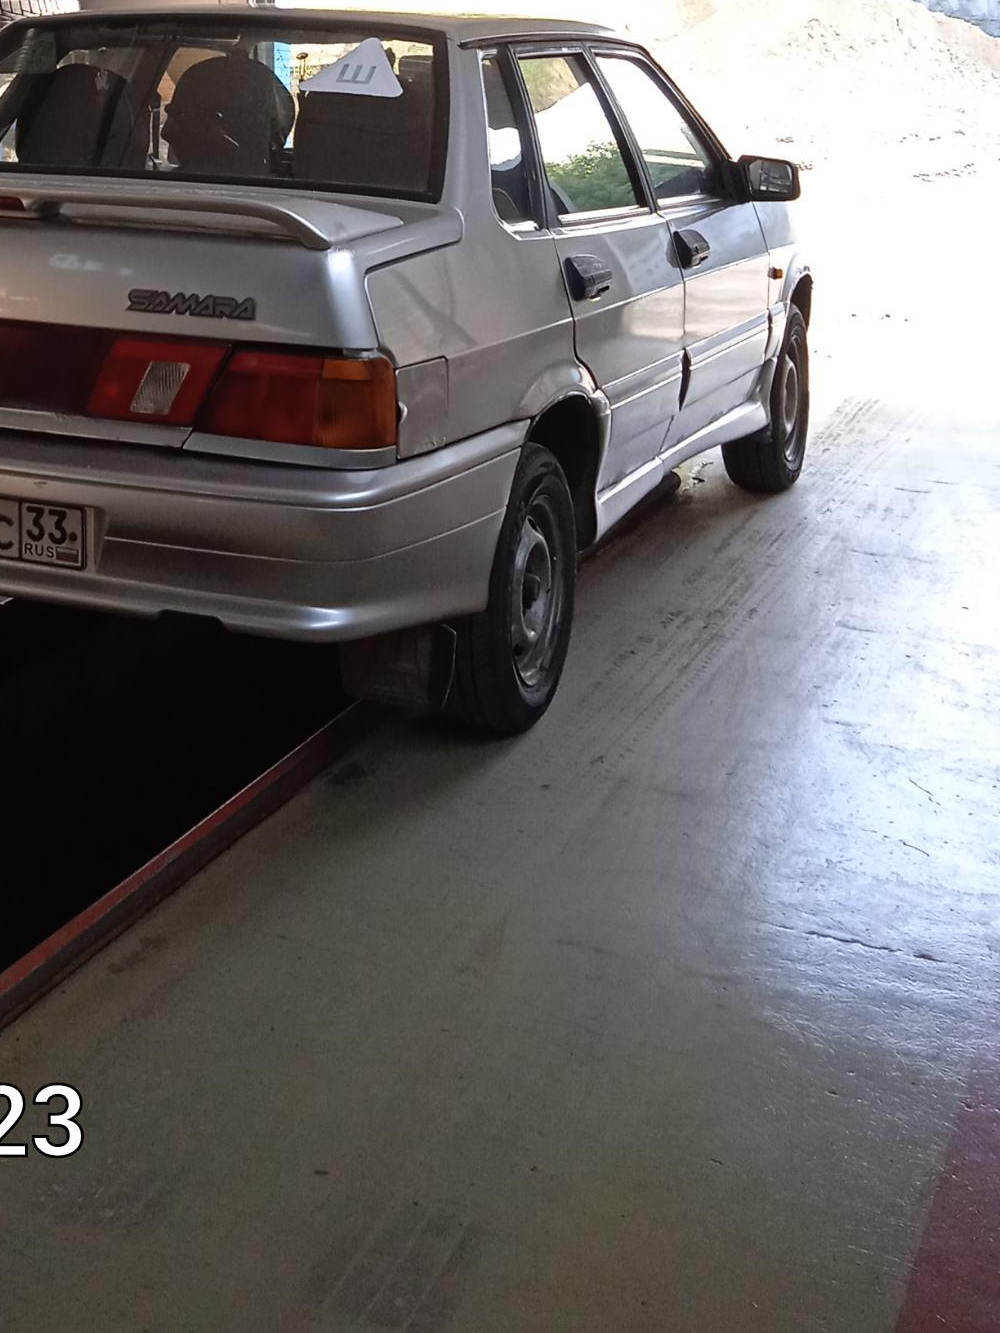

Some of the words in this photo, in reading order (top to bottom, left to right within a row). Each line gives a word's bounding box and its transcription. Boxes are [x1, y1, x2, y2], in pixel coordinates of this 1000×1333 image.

[336, 63, 377, 85] Ш
[125, 288, 257, 321] SAMARA
[25, 505, 68, 546] 33
[24, 542, 55, 559] RUS
